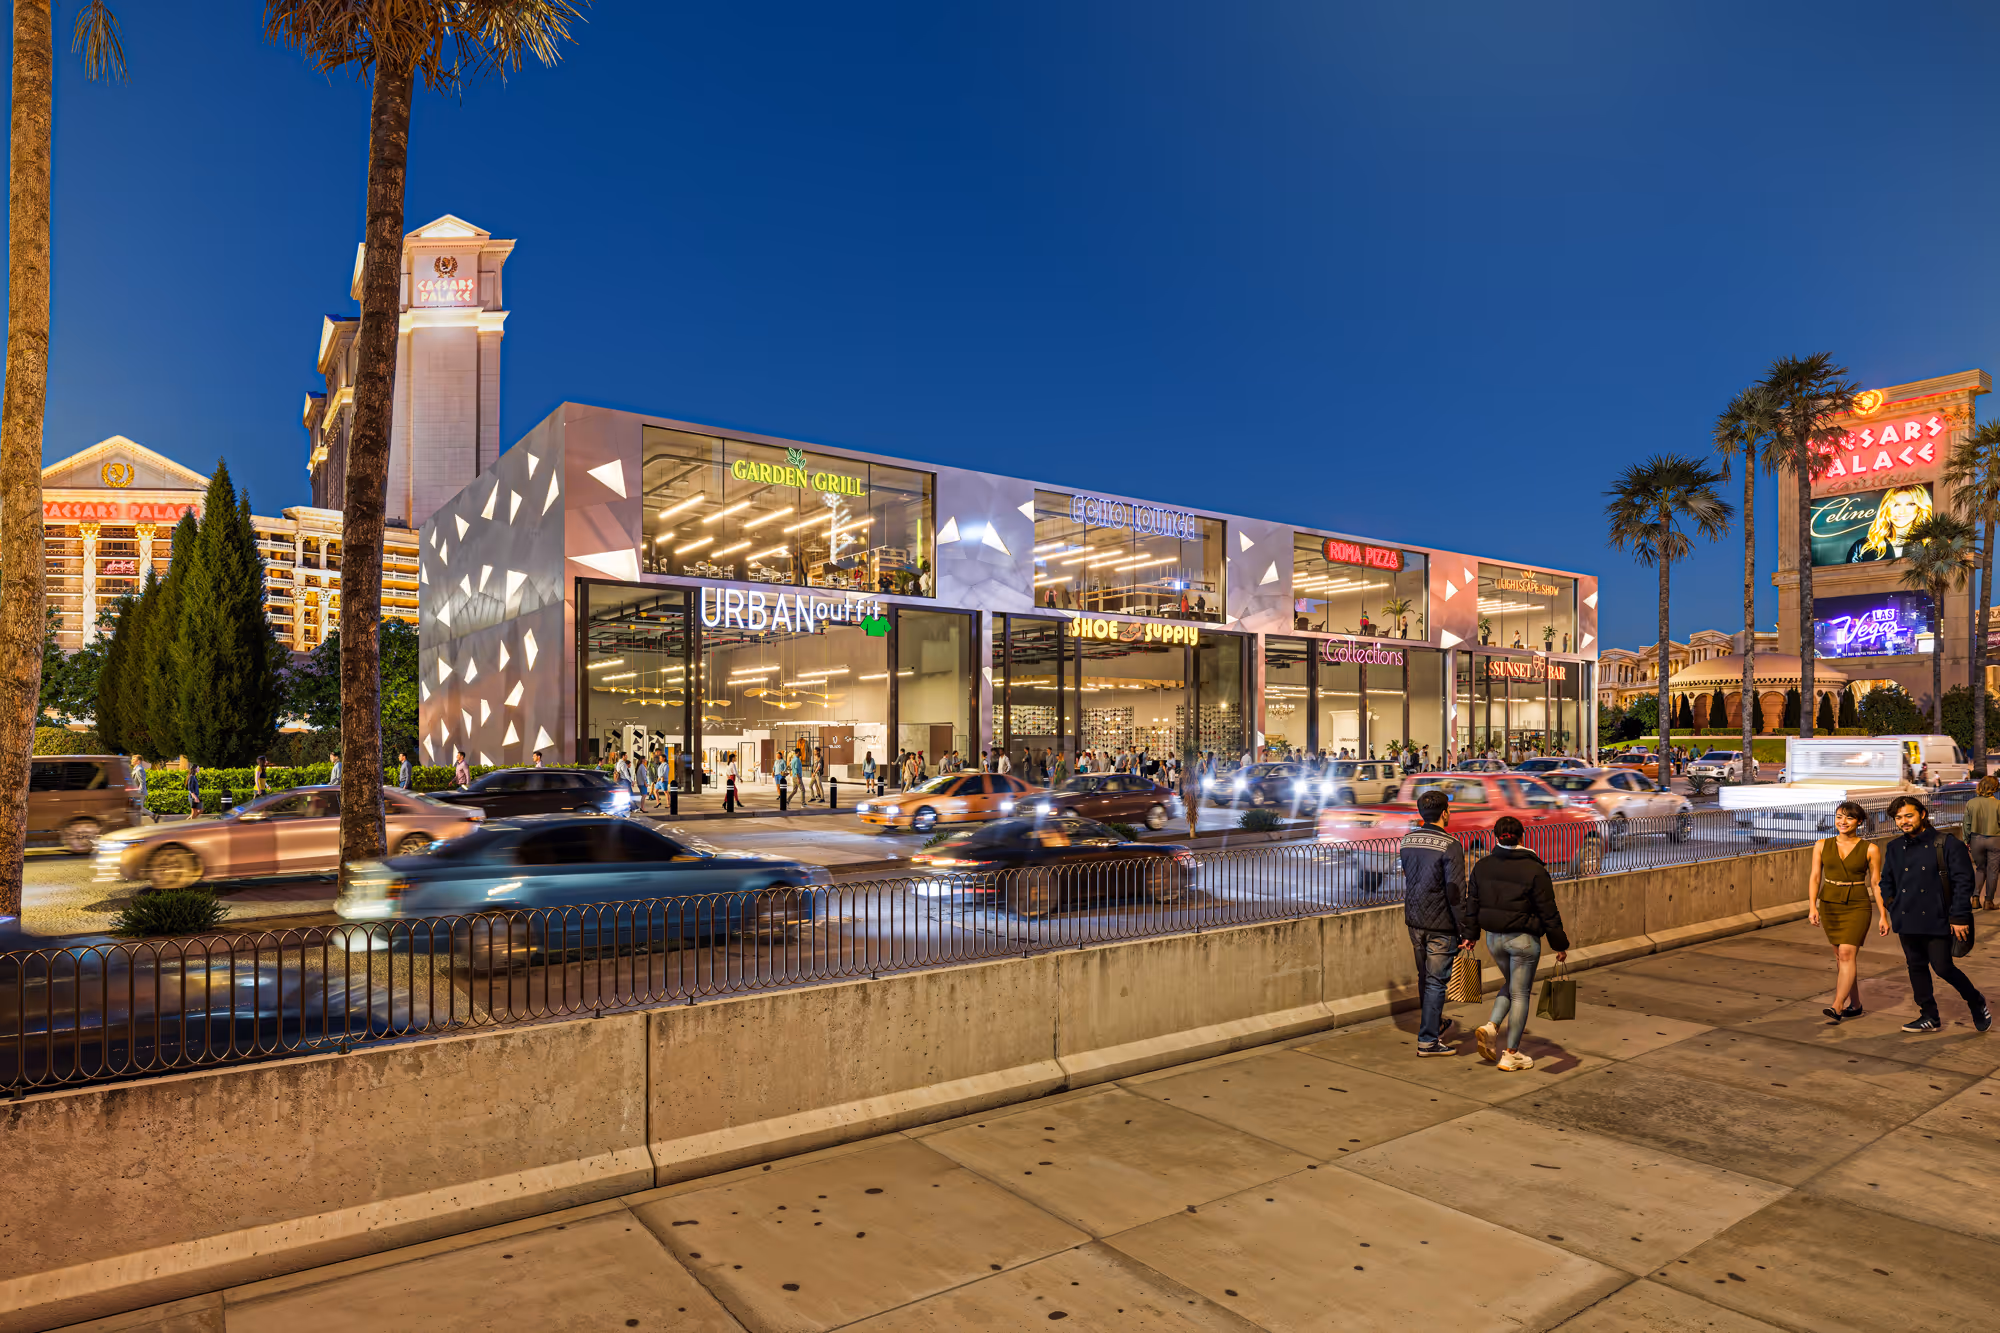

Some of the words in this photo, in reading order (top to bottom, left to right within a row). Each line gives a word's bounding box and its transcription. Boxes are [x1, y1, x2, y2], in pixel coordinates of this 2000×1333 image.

[418, 279, 474, 290] CAESARS
[421, 291, 471, 302] PALACE
[1808, 442, 1935, 481] ALACE
[732, 459, 808, 488] GARDEN
[812, 472, 866, 497] GRILL
[1072, 495, 1127, 529] ECHO
[1810, 497, 1876, 538] Celine
[1330, 541, 1362, 563] ROMA
[1365, 547, 1398, 569] PIZZA
[1541, 584, 1559, 596] SHOW
[1072, 617, 1118, 640] SHOE
[1832, 612, 1907, 644] Vegas
[1874, 610, 1894, 620] LAS
[1325, 638, 1404, 666] Collections
[1493, 660, 1532, 678] SUNSET
[1547, 665, 1566, 680] BAR
